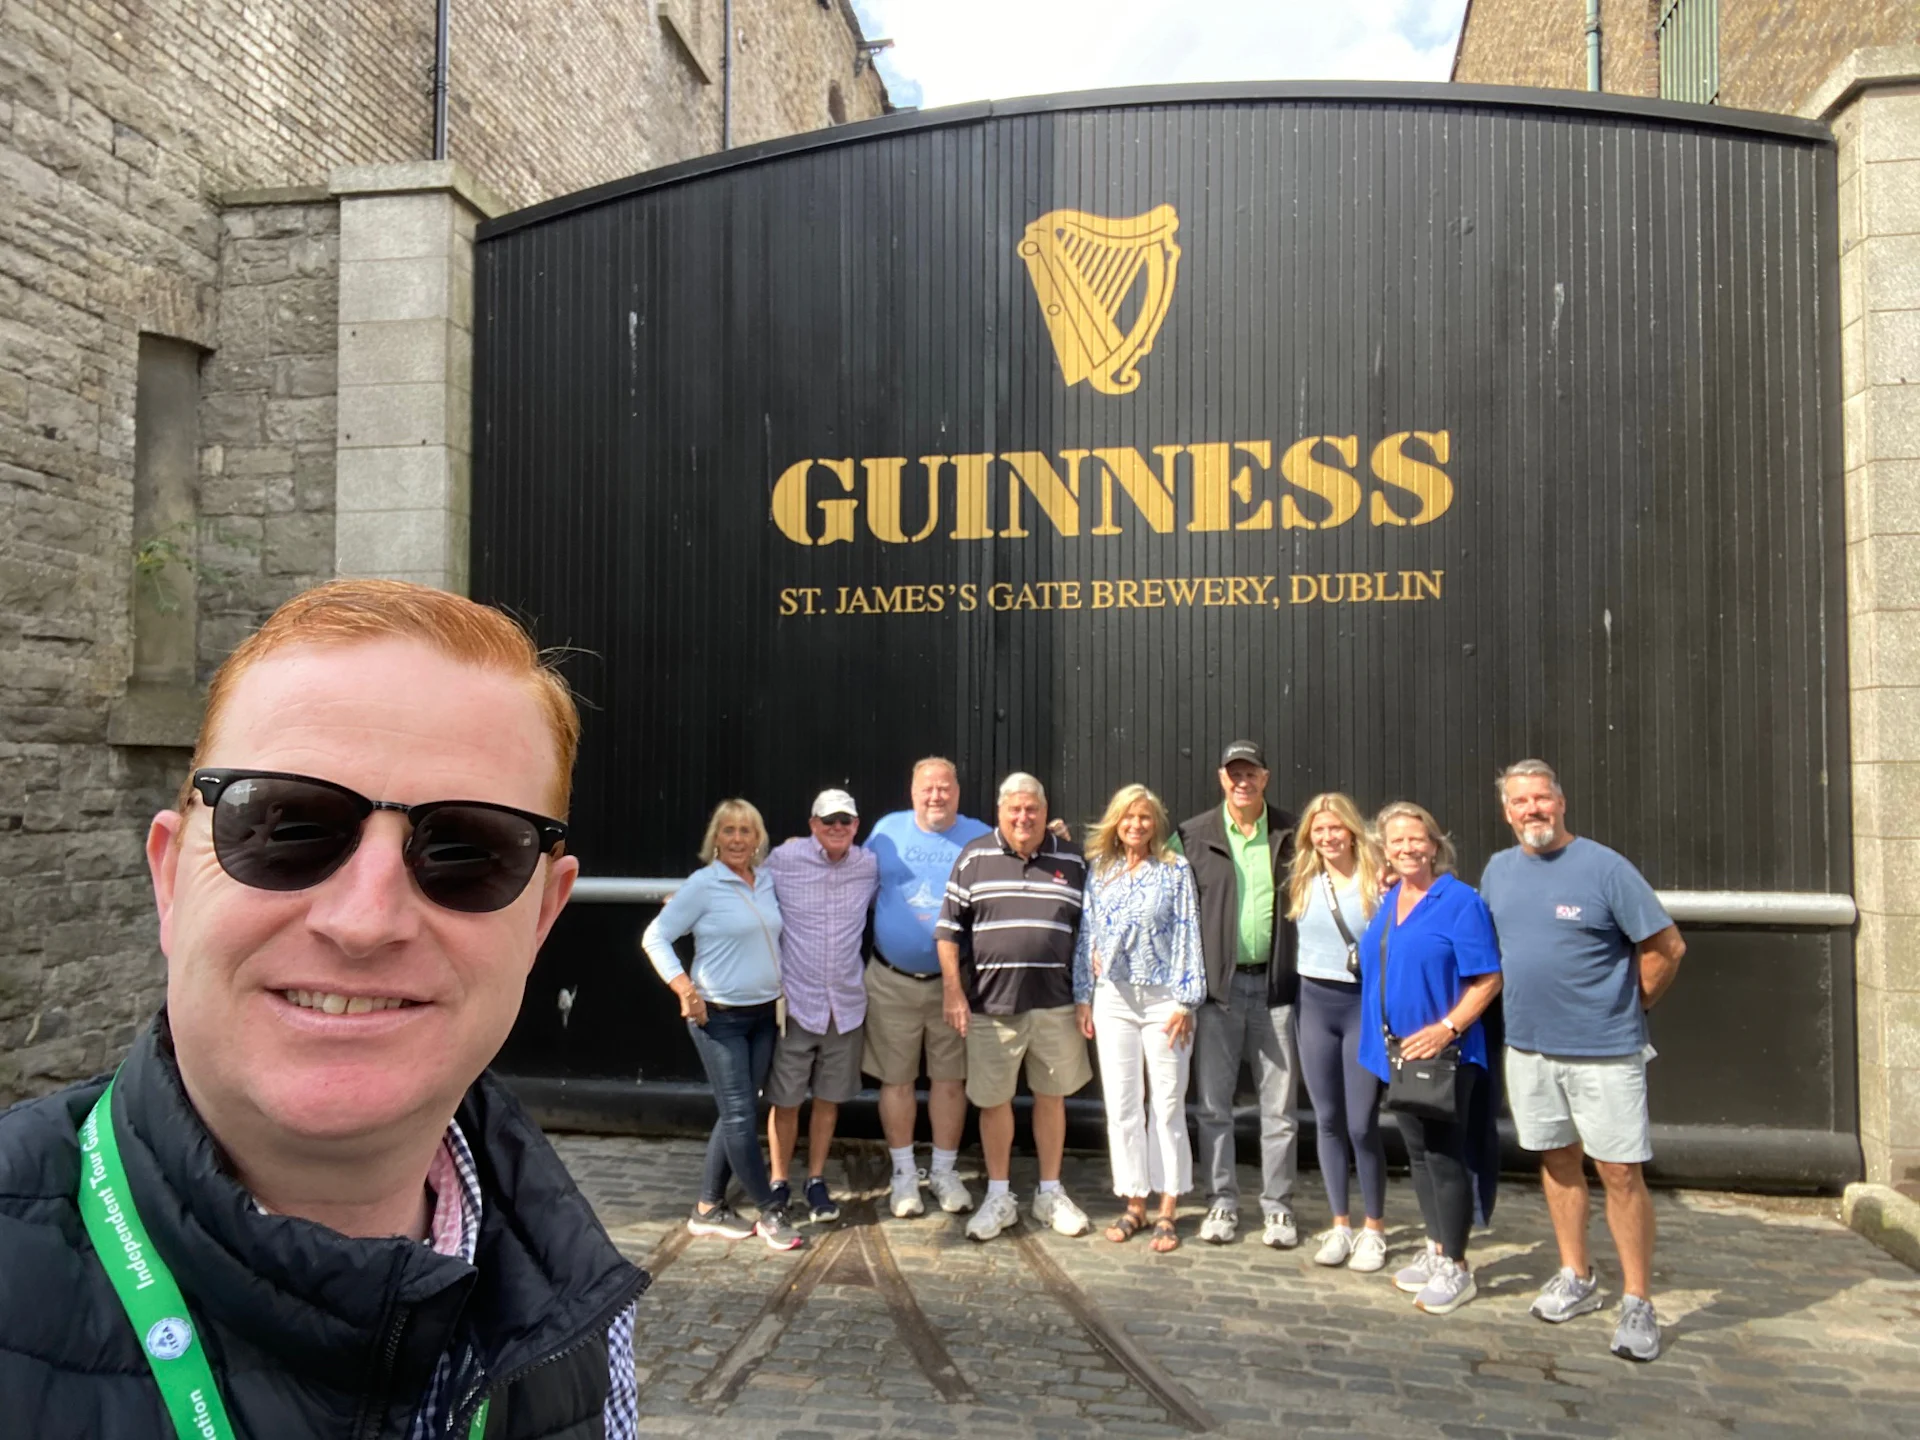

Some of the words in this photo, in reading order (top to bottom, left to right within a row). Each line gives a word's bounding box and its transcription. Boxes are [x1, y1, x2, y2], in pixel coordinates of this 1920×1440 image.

[771, 429, 1455, 546] GUINNESS
[779, 587, 827, 615] ST.
[835, 583, 978, 614] JAMES’S
[987, 580, 1083, 611] GATE
[1091, 575, 1281, 610] BREWERY,
[1289, 569, 1445, 605] DUBLIN
[89, 1151, 108, 1190] Tour
[98, 1186, 156, 1290] Independent
